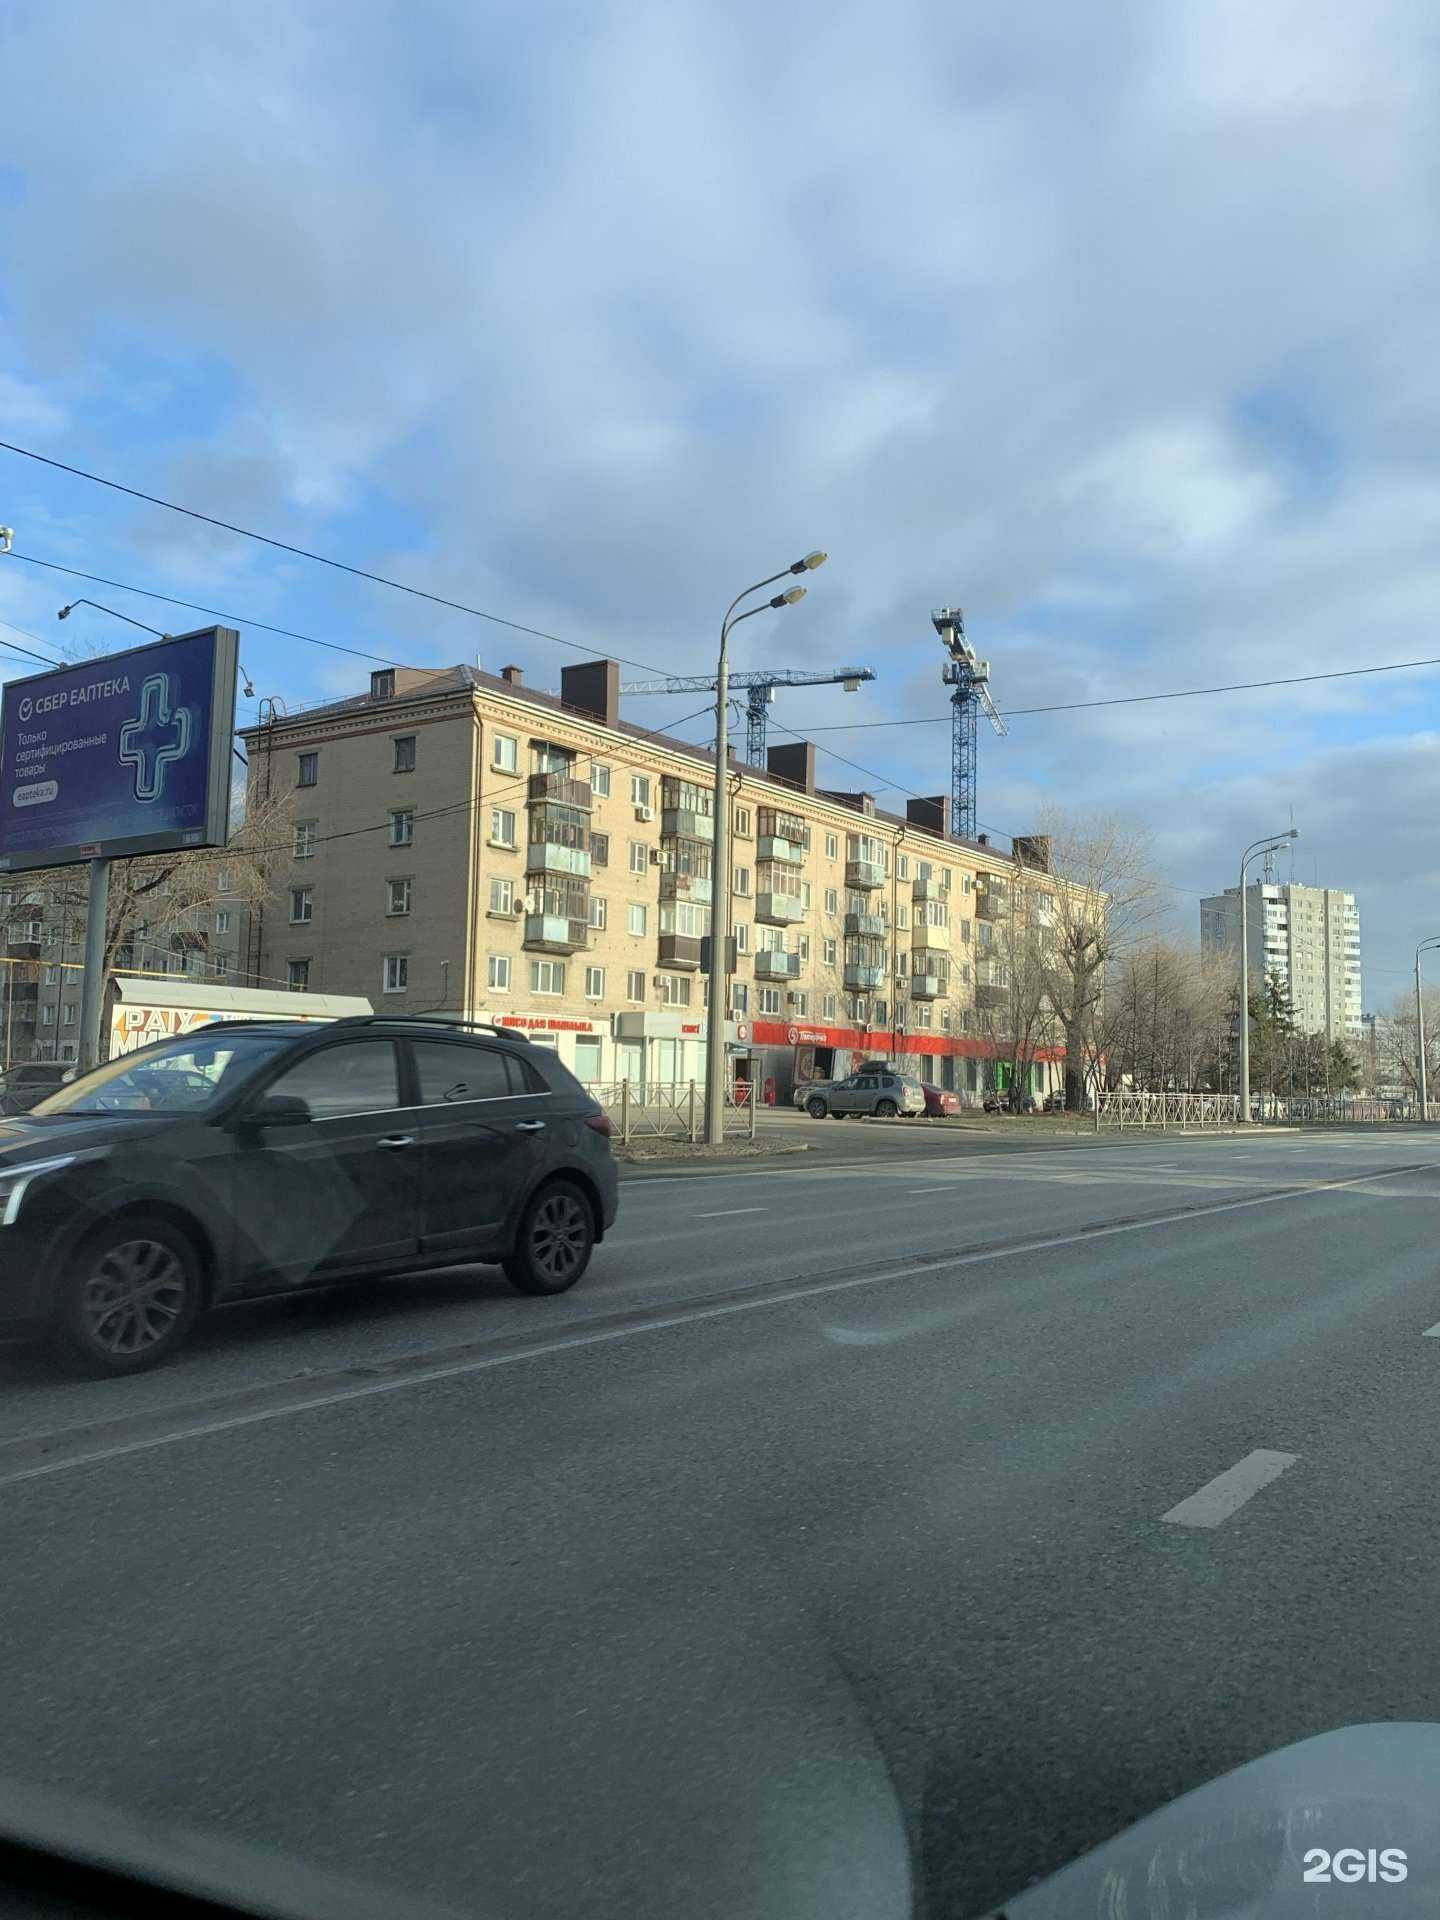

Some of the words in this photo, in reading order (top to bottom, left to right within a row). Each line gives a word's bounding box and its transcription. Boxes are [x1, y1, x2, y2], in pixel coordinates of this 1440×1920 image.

[35, 692, 68, 715] СБЕР
[69, 676, 131, 706] ЕАПТЕКА
[15, 733, 108, 762] сертифицированные
[17, 730, 48, 746] Только
[15, 763, 46, 778] товары
[125, 1009, 194, 1034] PAIX
